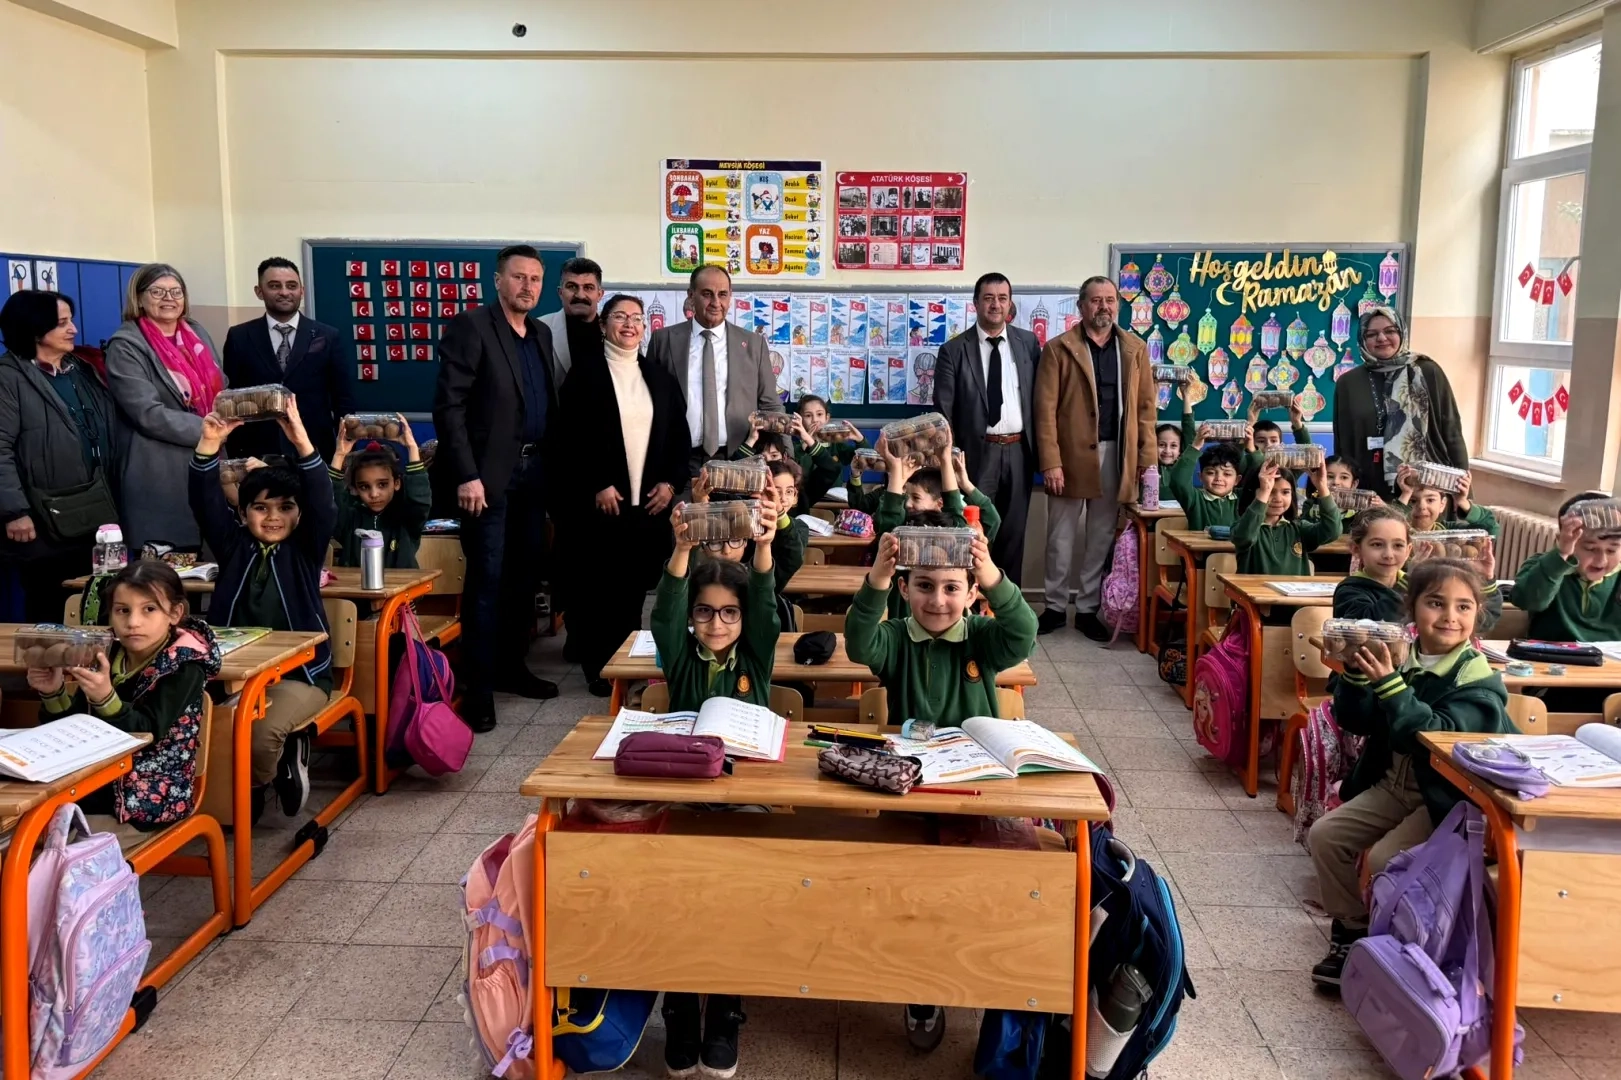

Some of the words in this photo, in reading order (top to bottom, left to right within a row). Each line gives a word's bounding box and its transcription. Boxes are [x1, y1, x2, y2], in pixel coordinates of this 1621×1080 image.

[759, 176, 769, 184] KIŞ
[870, 174, 903, 182] ATATÜRK
[905, 174, 932, 184] KÖŞESİ
[671, 226, 699, 234] İLKBAHAR
[1241, 266, 1362, 314] Ramazan
